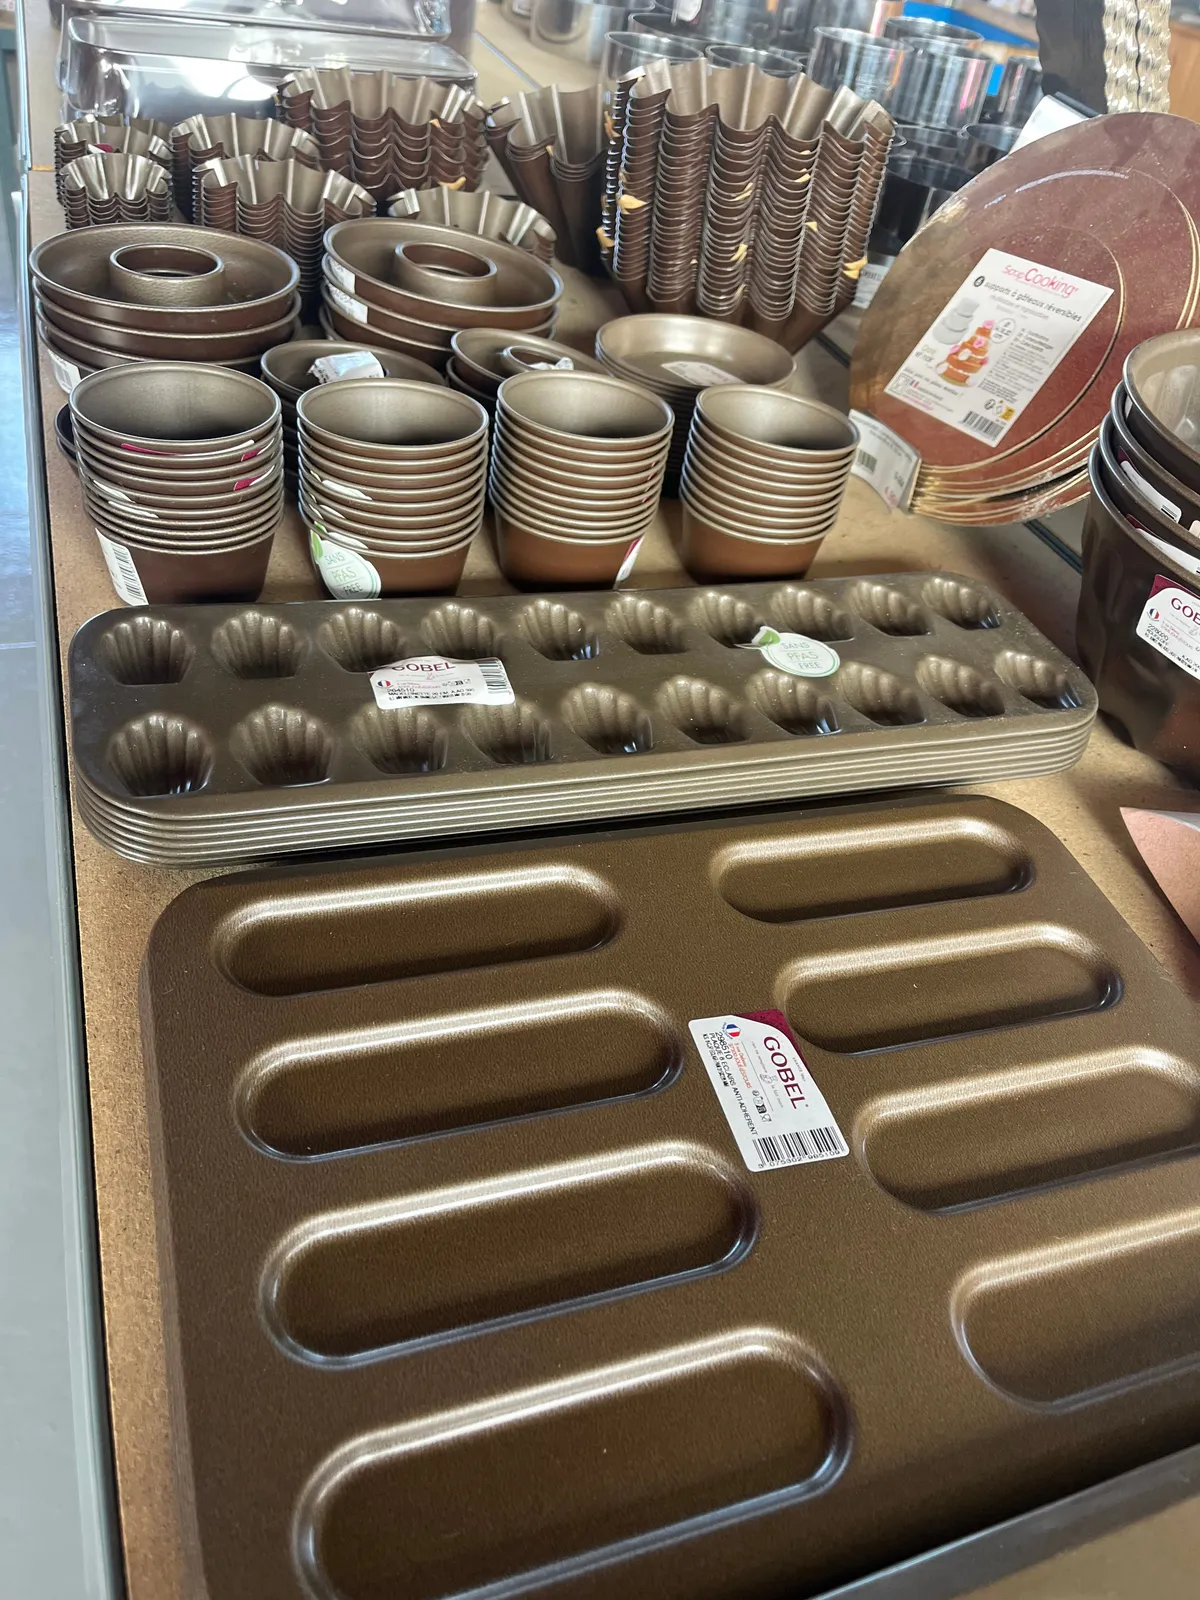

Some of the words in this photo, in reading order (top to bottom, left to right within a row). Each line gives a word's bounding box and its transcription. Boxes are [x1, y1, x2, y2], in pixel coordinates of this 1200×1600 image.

[324, 552, 346, 565] SANS
[331, 566, 357, 583] PFAS
[343, 582, 364, 596] FREE
[781, 641, 810, 650] SANS
[786, 651, 819, 661] PFAS
[798, 661, 822, 670] FREE
[715, 1031, 733, 1060] 298510
[763, 1036, 806, 1110] GOBEL
[709, 1032, 724, 1056] PLAQUE
[721, 1061, 736, 1086] ECLAIRS
[732, 1085, 758, 1136] ANTI-ADHERENT
